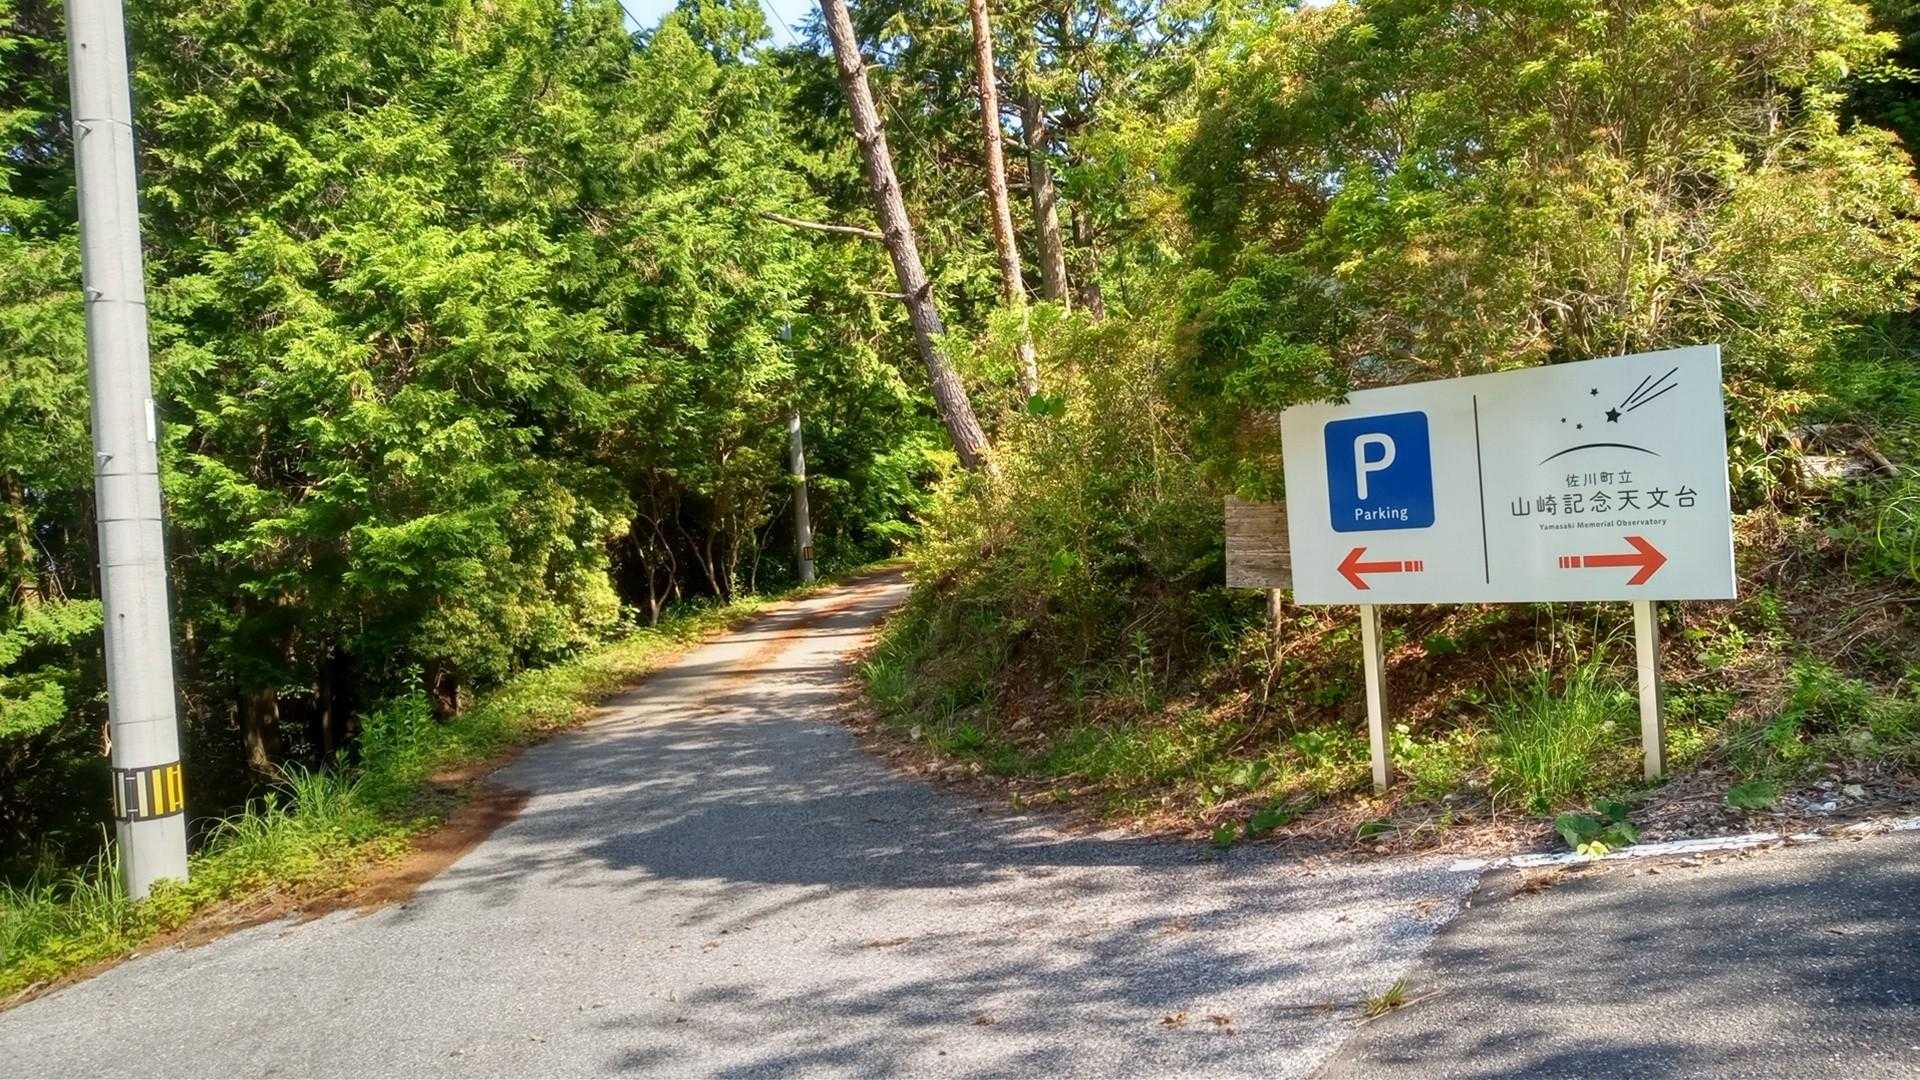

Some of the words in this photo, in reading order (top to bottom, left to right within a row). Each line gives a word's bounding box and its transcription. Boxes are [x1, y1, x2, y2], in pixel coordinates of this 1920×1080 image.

[1353, 433, 1396, 500] P
[1566, 470, 1633, 488] 佐川町立
[1511, 485, 1698, 517] 山崎記念天文台
[1354, 506, 1408, 521] Parking
[1539, 522, 1575, 531] Yamasaki
[1576, 520, 1614, 529] Memorial
[1616, 518, 1667, 527] Observatory
